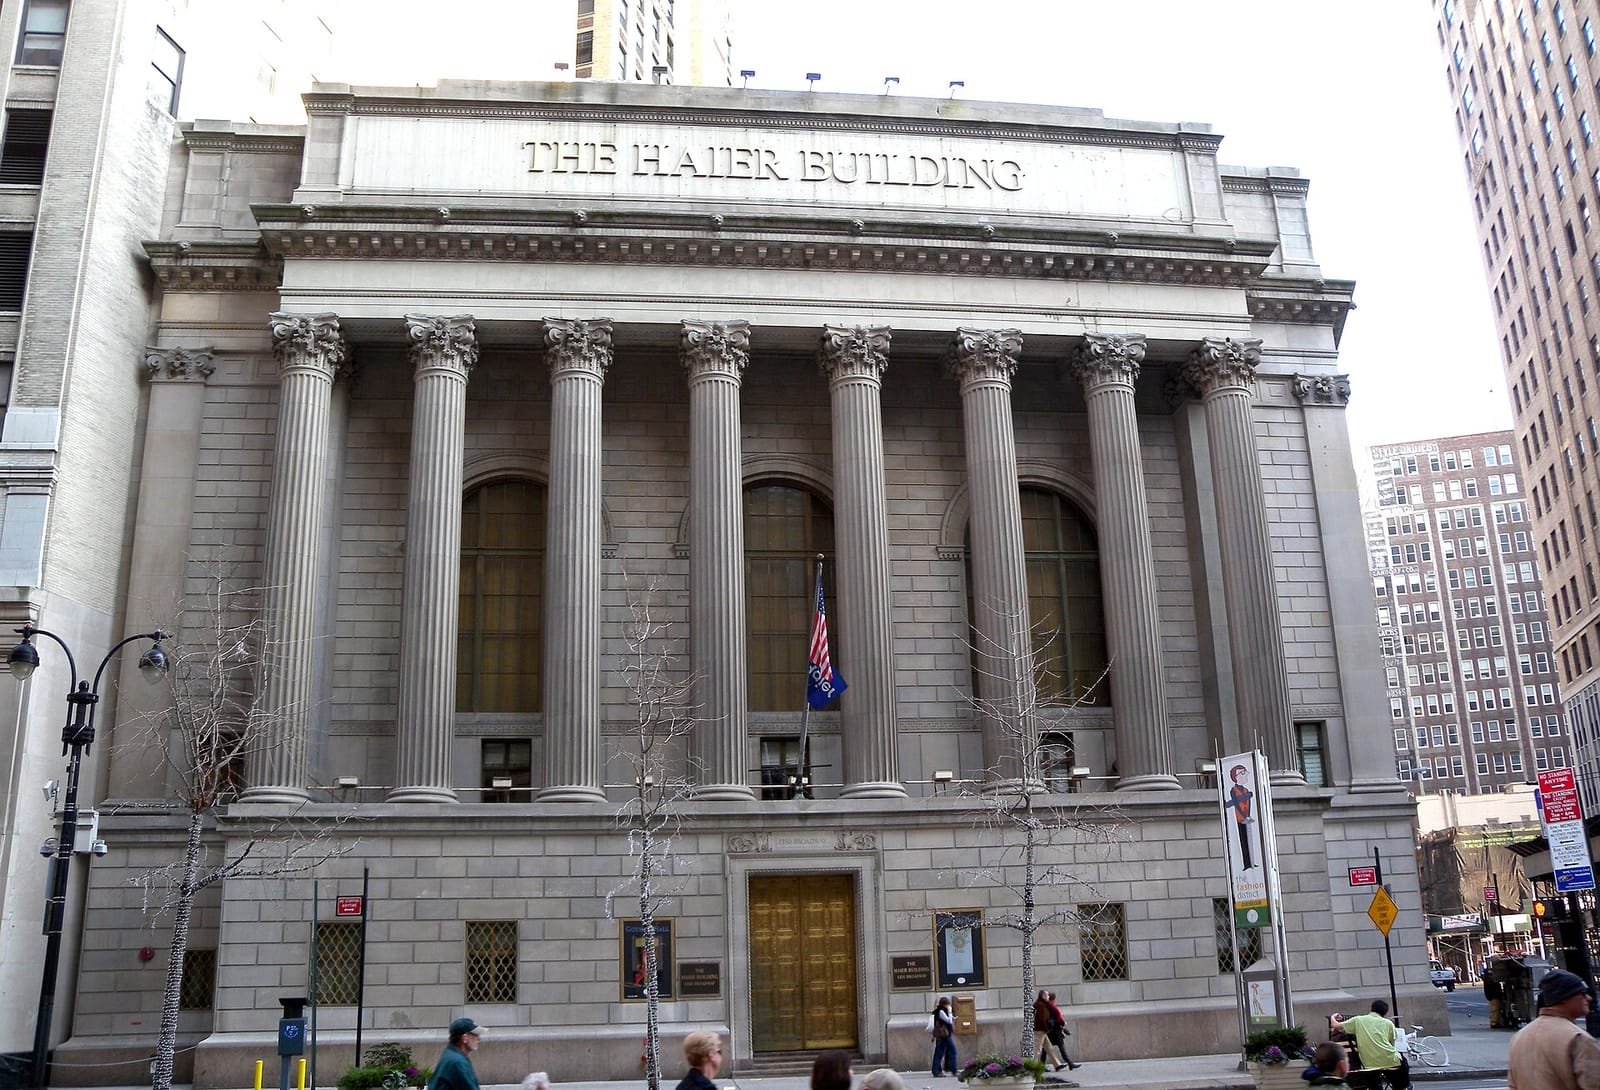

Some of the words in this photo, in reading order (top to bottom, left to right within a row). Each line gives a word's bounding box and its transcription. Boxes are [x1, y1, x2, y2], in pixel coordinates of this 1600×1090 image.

[522, 140, 617, 174] THE
[632, 142, 789, 182] HAIER
[798, 148, 1025, 193] BUILDING
[1236, 882, 1264, 891] fashion
